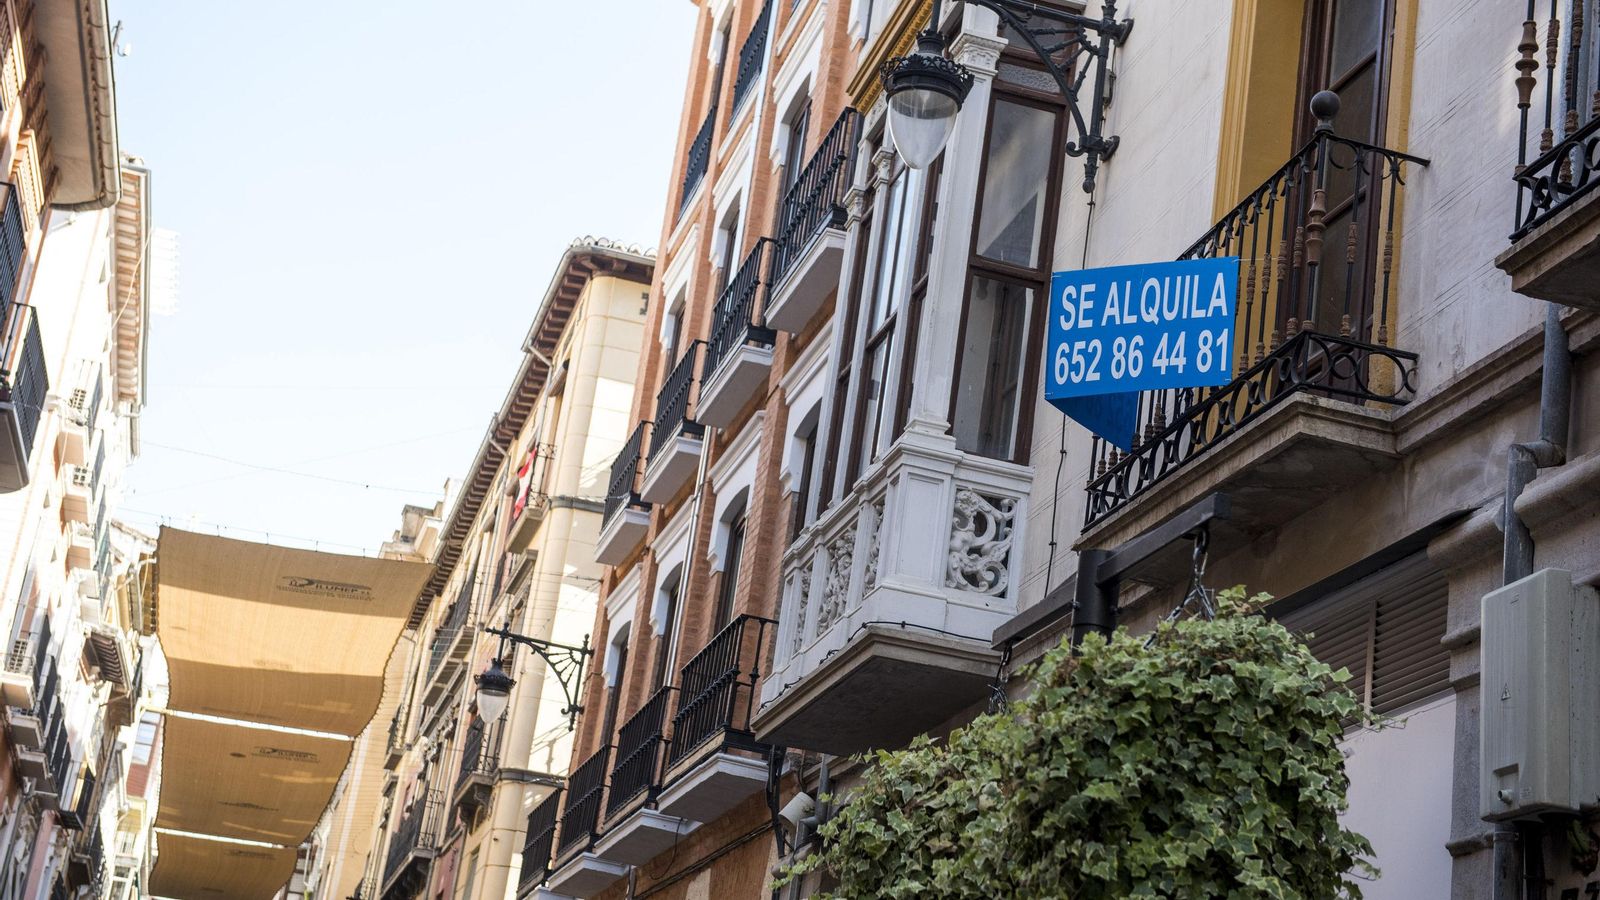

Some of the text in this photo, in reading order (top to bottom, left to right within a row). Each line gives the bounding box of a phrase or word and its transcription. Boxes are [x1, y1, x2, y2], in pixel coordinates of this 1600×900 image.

[1060, 272, 1228, 331] SE ALQUILA
[1054, 328, 1229, 385] 652 86 44 81
